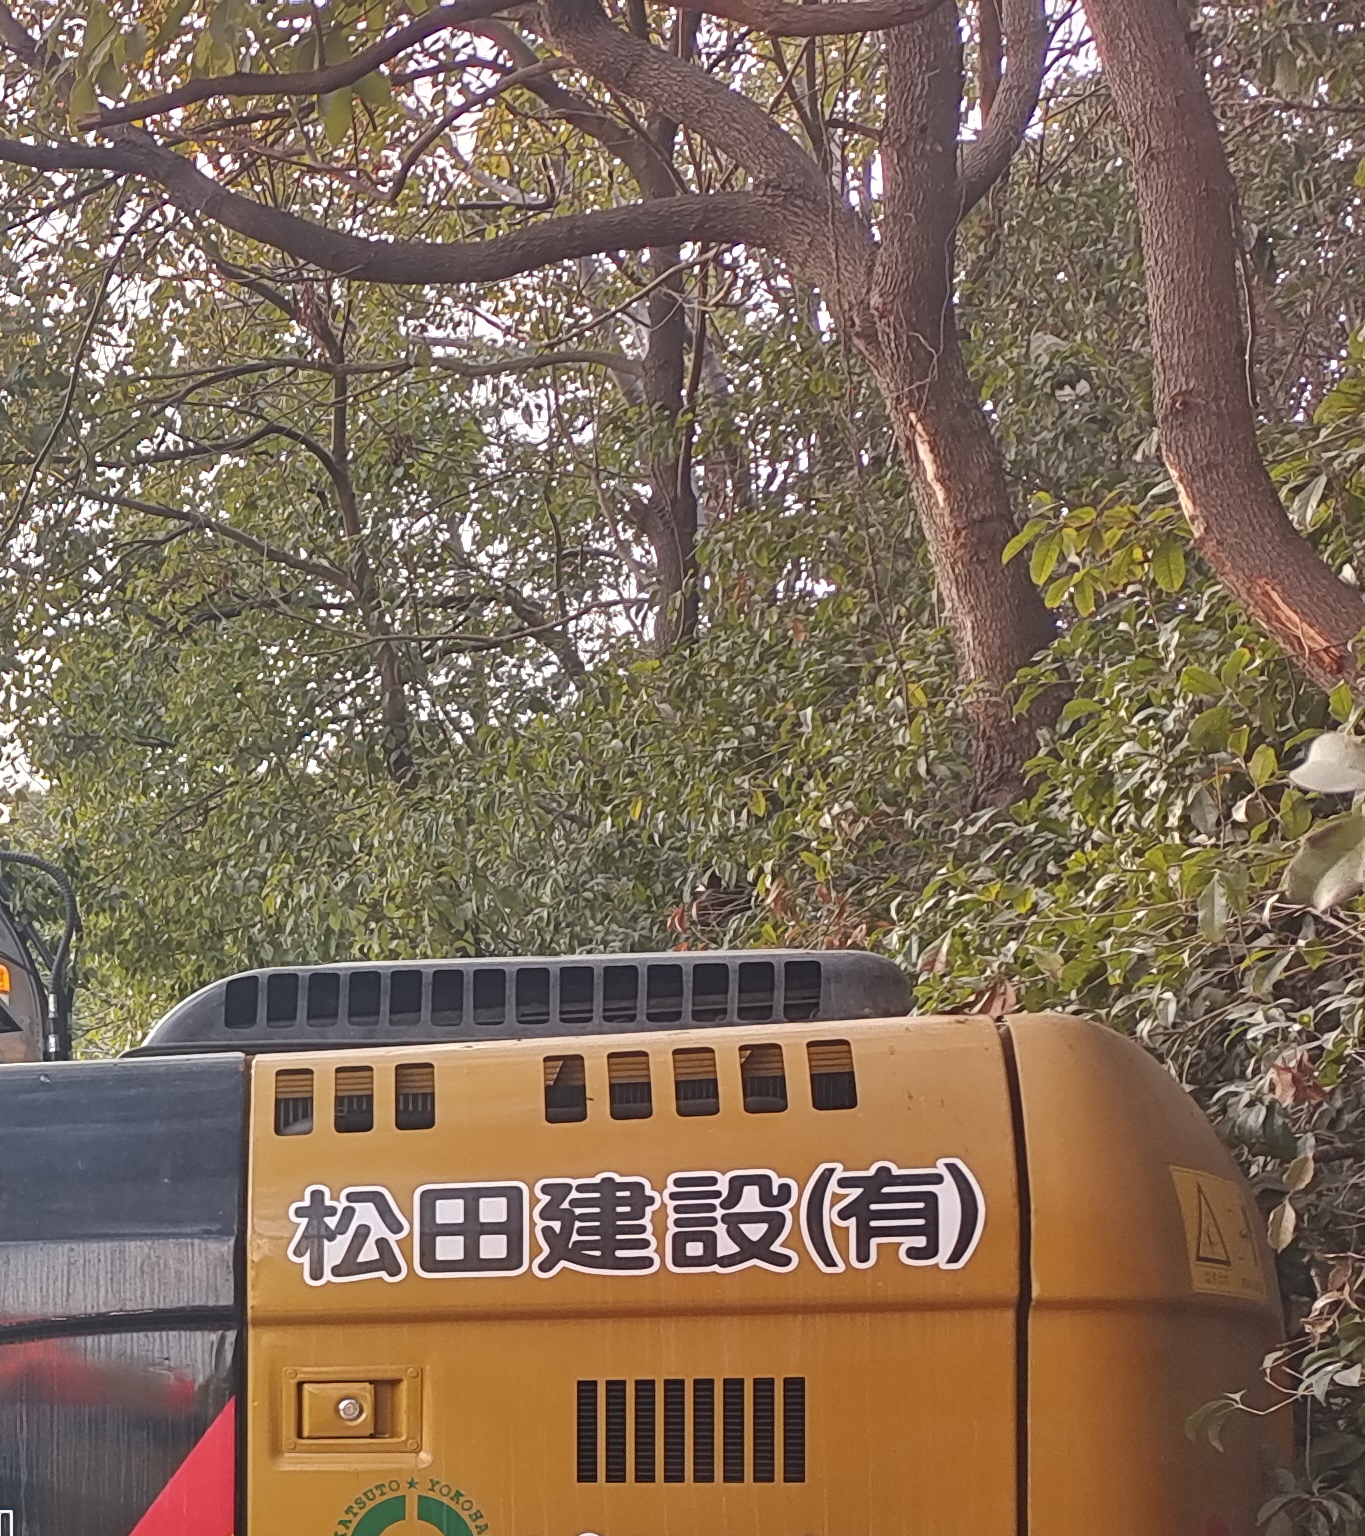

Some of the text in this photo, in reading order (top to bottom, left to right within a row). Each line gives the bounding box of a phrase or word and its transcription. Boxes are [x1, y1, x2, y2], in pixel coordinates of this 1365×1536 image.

[290, 1160, 984, 1284] 松田建設(有)
